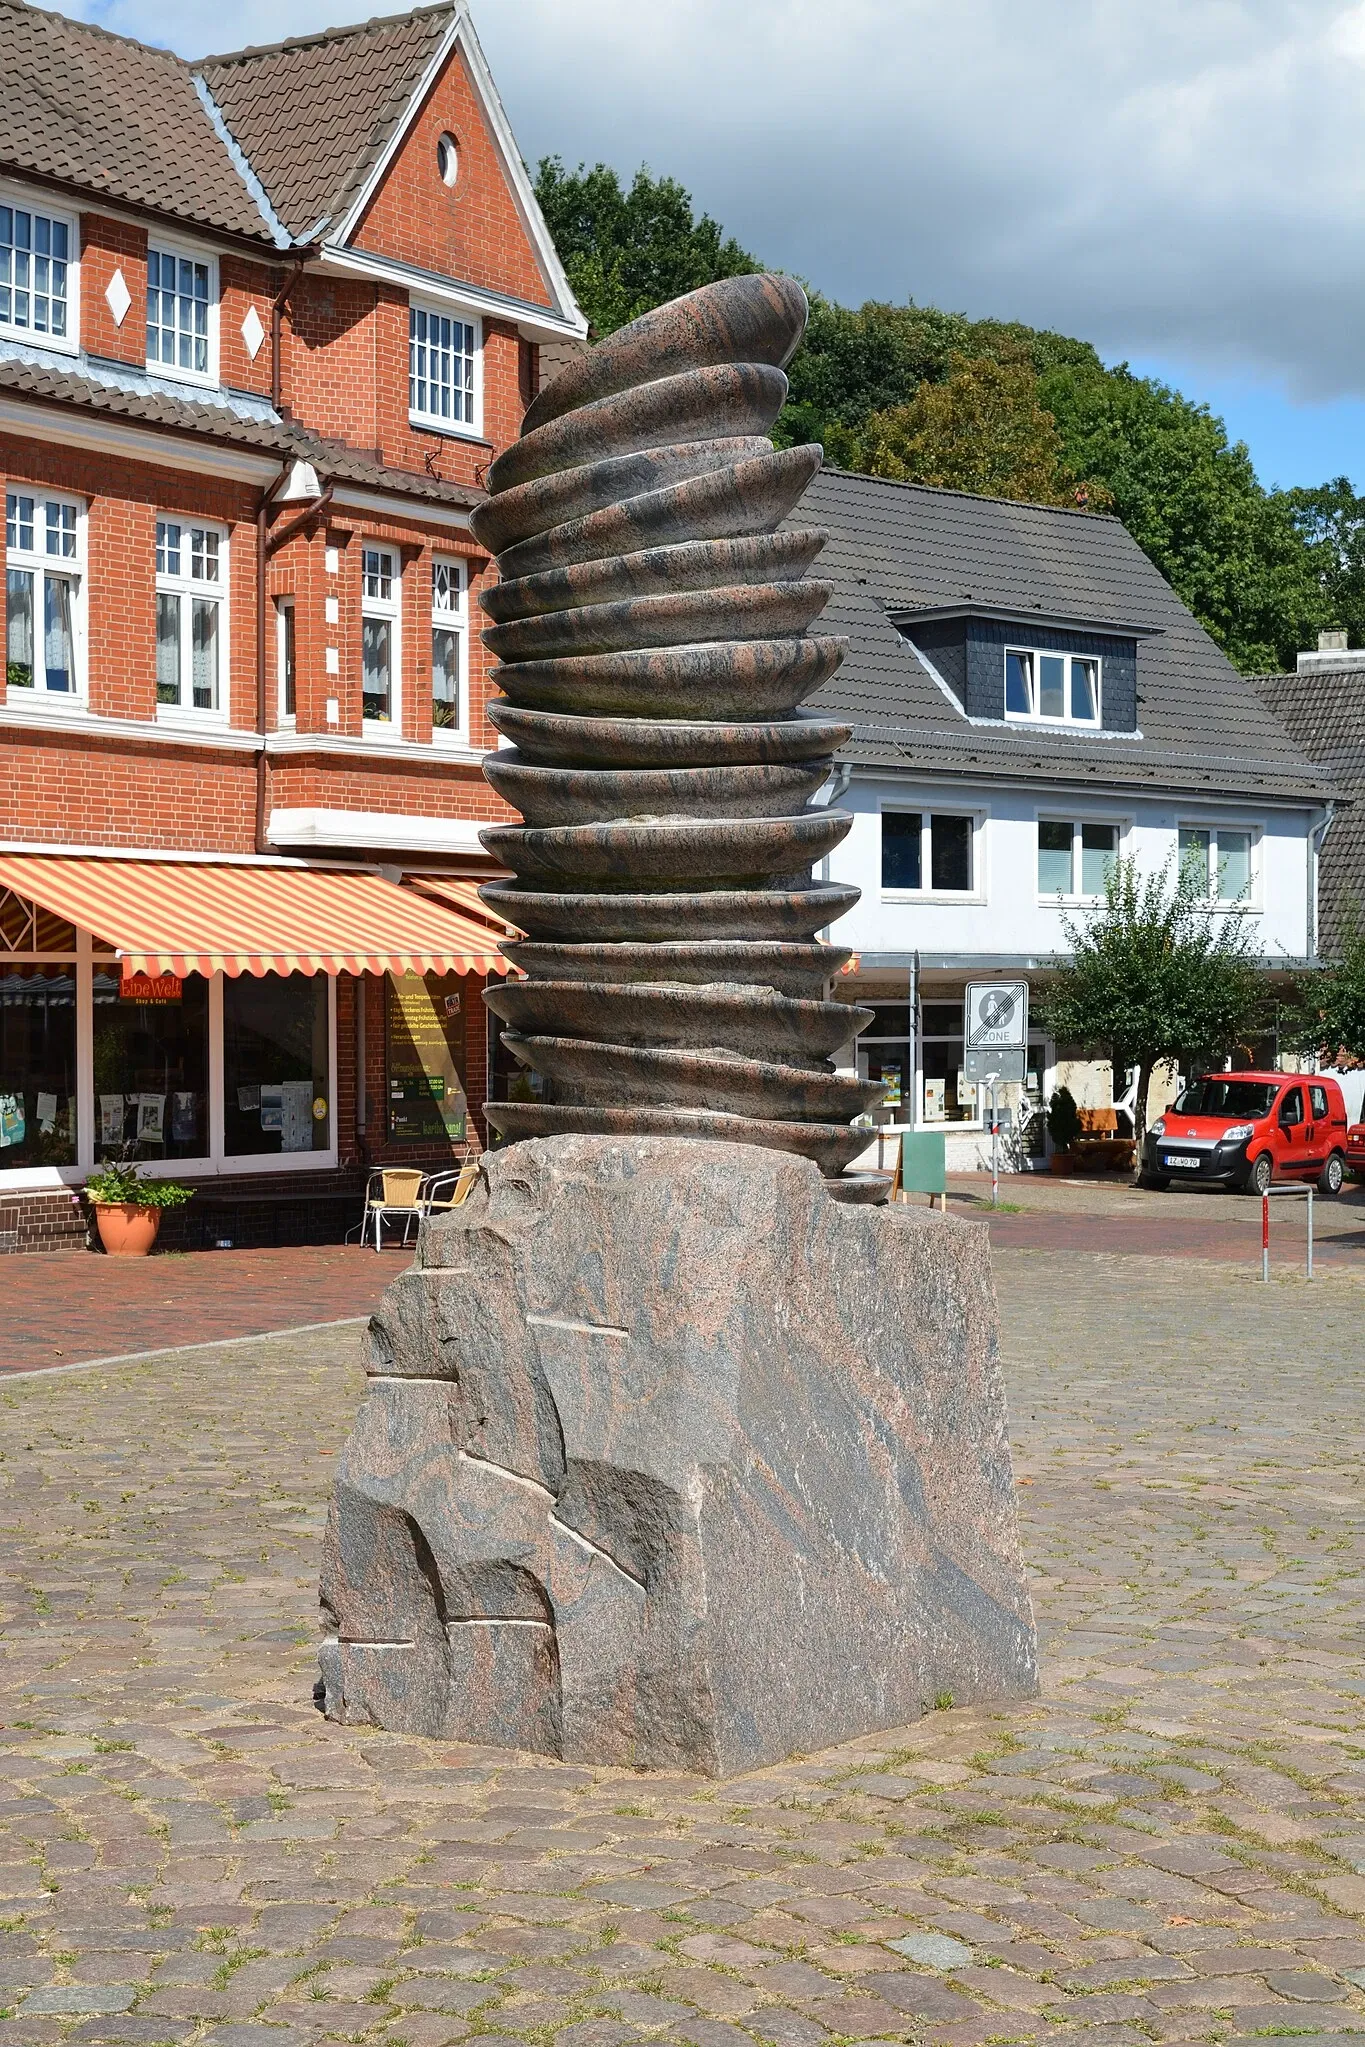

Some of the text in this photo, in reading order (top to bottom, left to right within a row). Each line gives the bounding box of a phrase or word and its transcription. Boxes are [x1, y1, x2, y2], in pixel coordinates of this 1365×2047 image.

[121, 977, 181, 997] Eine Welt
[983, 1031, 1010, 1042] ZONE
